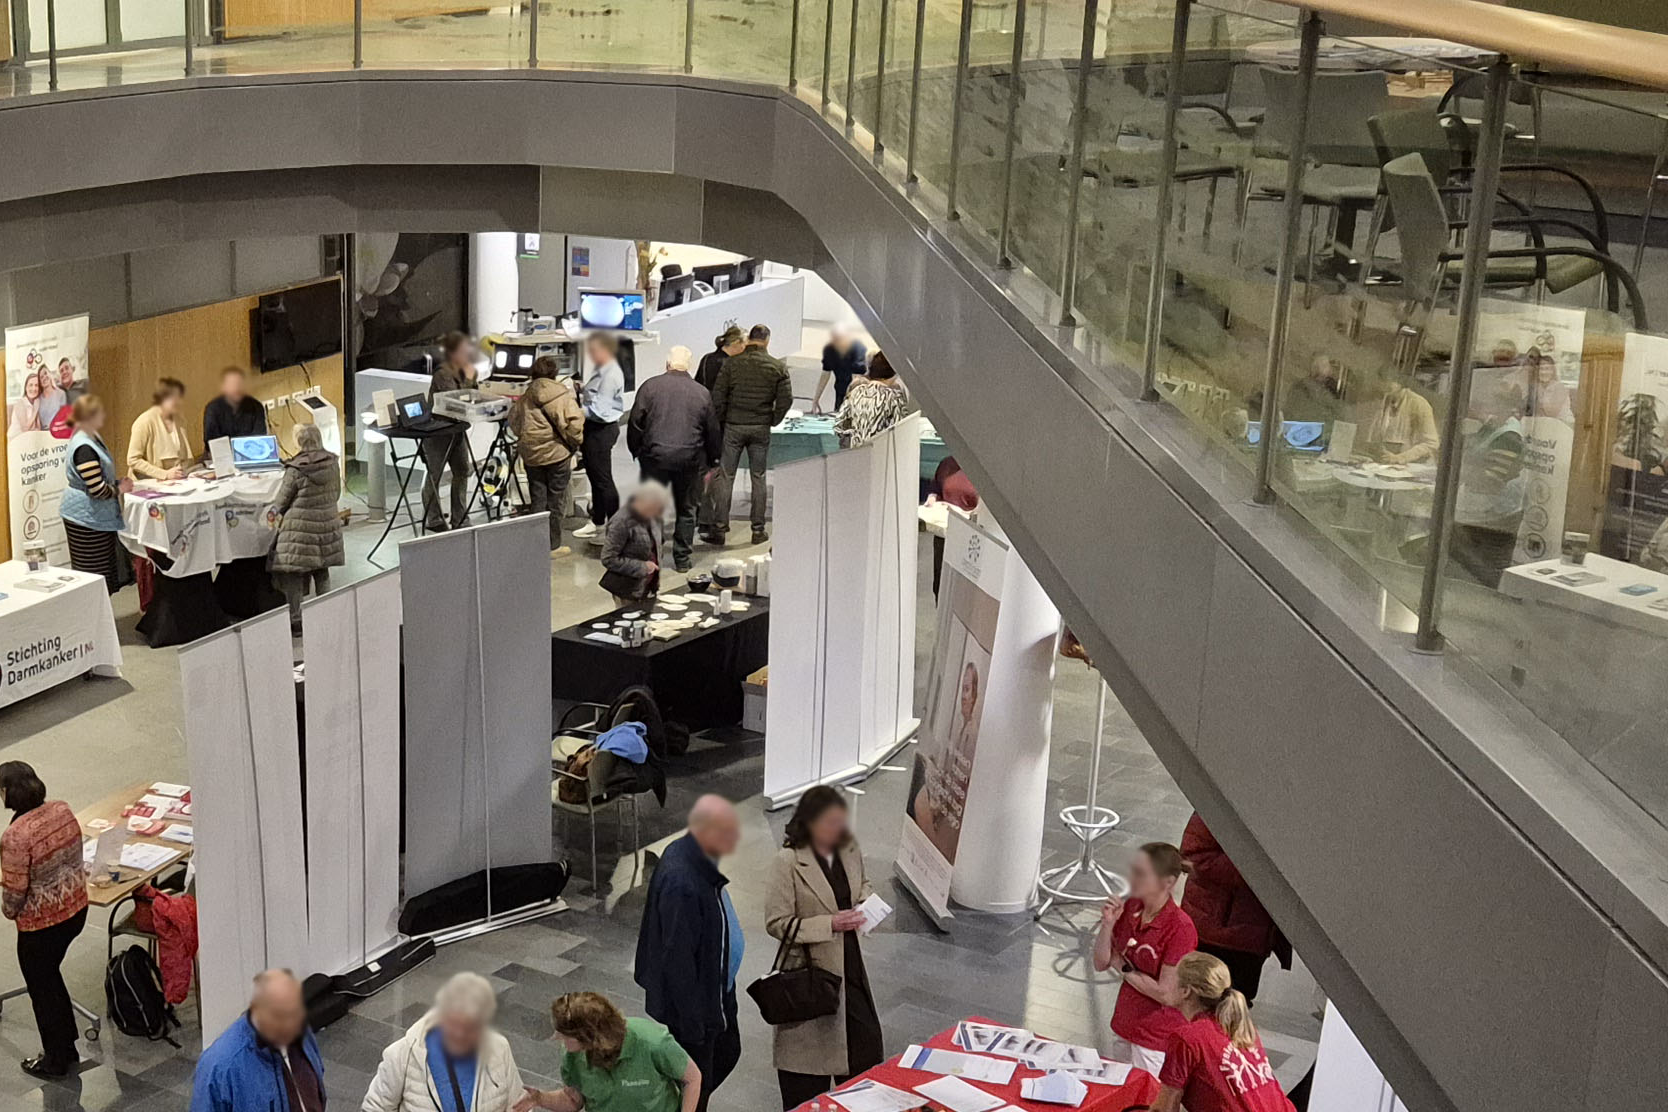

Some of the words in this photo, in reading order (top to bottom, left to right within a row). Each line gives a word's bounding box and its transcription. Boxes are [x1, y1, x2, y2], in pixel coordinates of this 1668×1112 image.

[21, 450, 39, 462] Voor
[40, 447, 50, 456] de
[20, 457, 59, 476] opsporing
[21, 472, 46, 486] kanker
[7, 636, 61, 666] Stichting
[8, 647, 78, 686] Darmkanker
